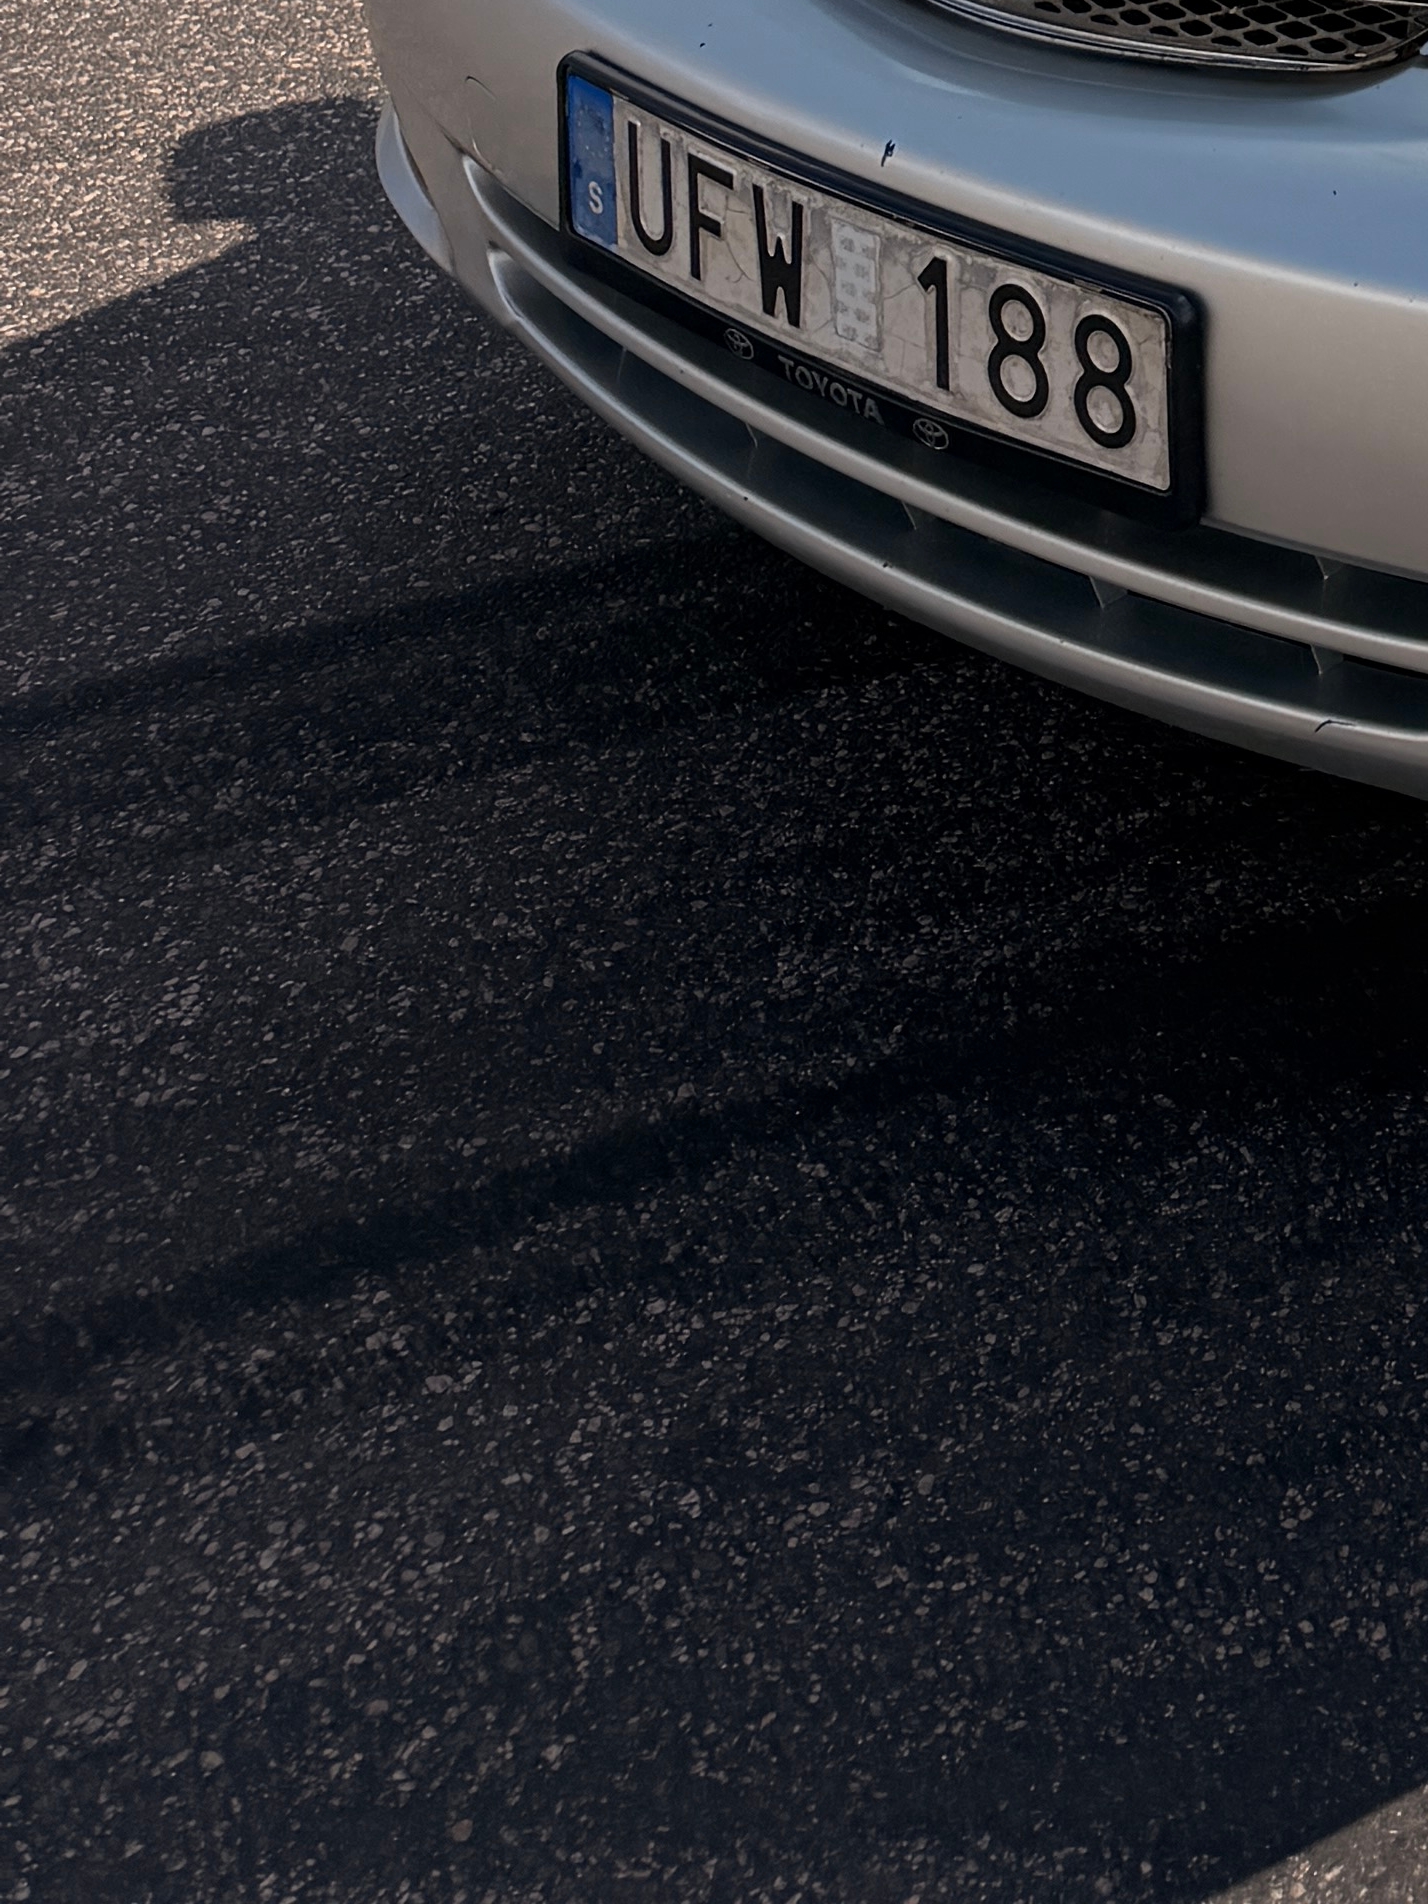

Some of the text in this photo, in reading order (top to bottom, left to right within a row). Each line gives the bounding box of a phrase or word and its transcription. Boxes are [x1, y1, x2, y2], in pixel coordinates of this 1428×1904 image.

[585, 181, 605, 215] S
[625, 119, 1138, 451] UFW 188
[776, 356, 887, 426] TOYOTA
